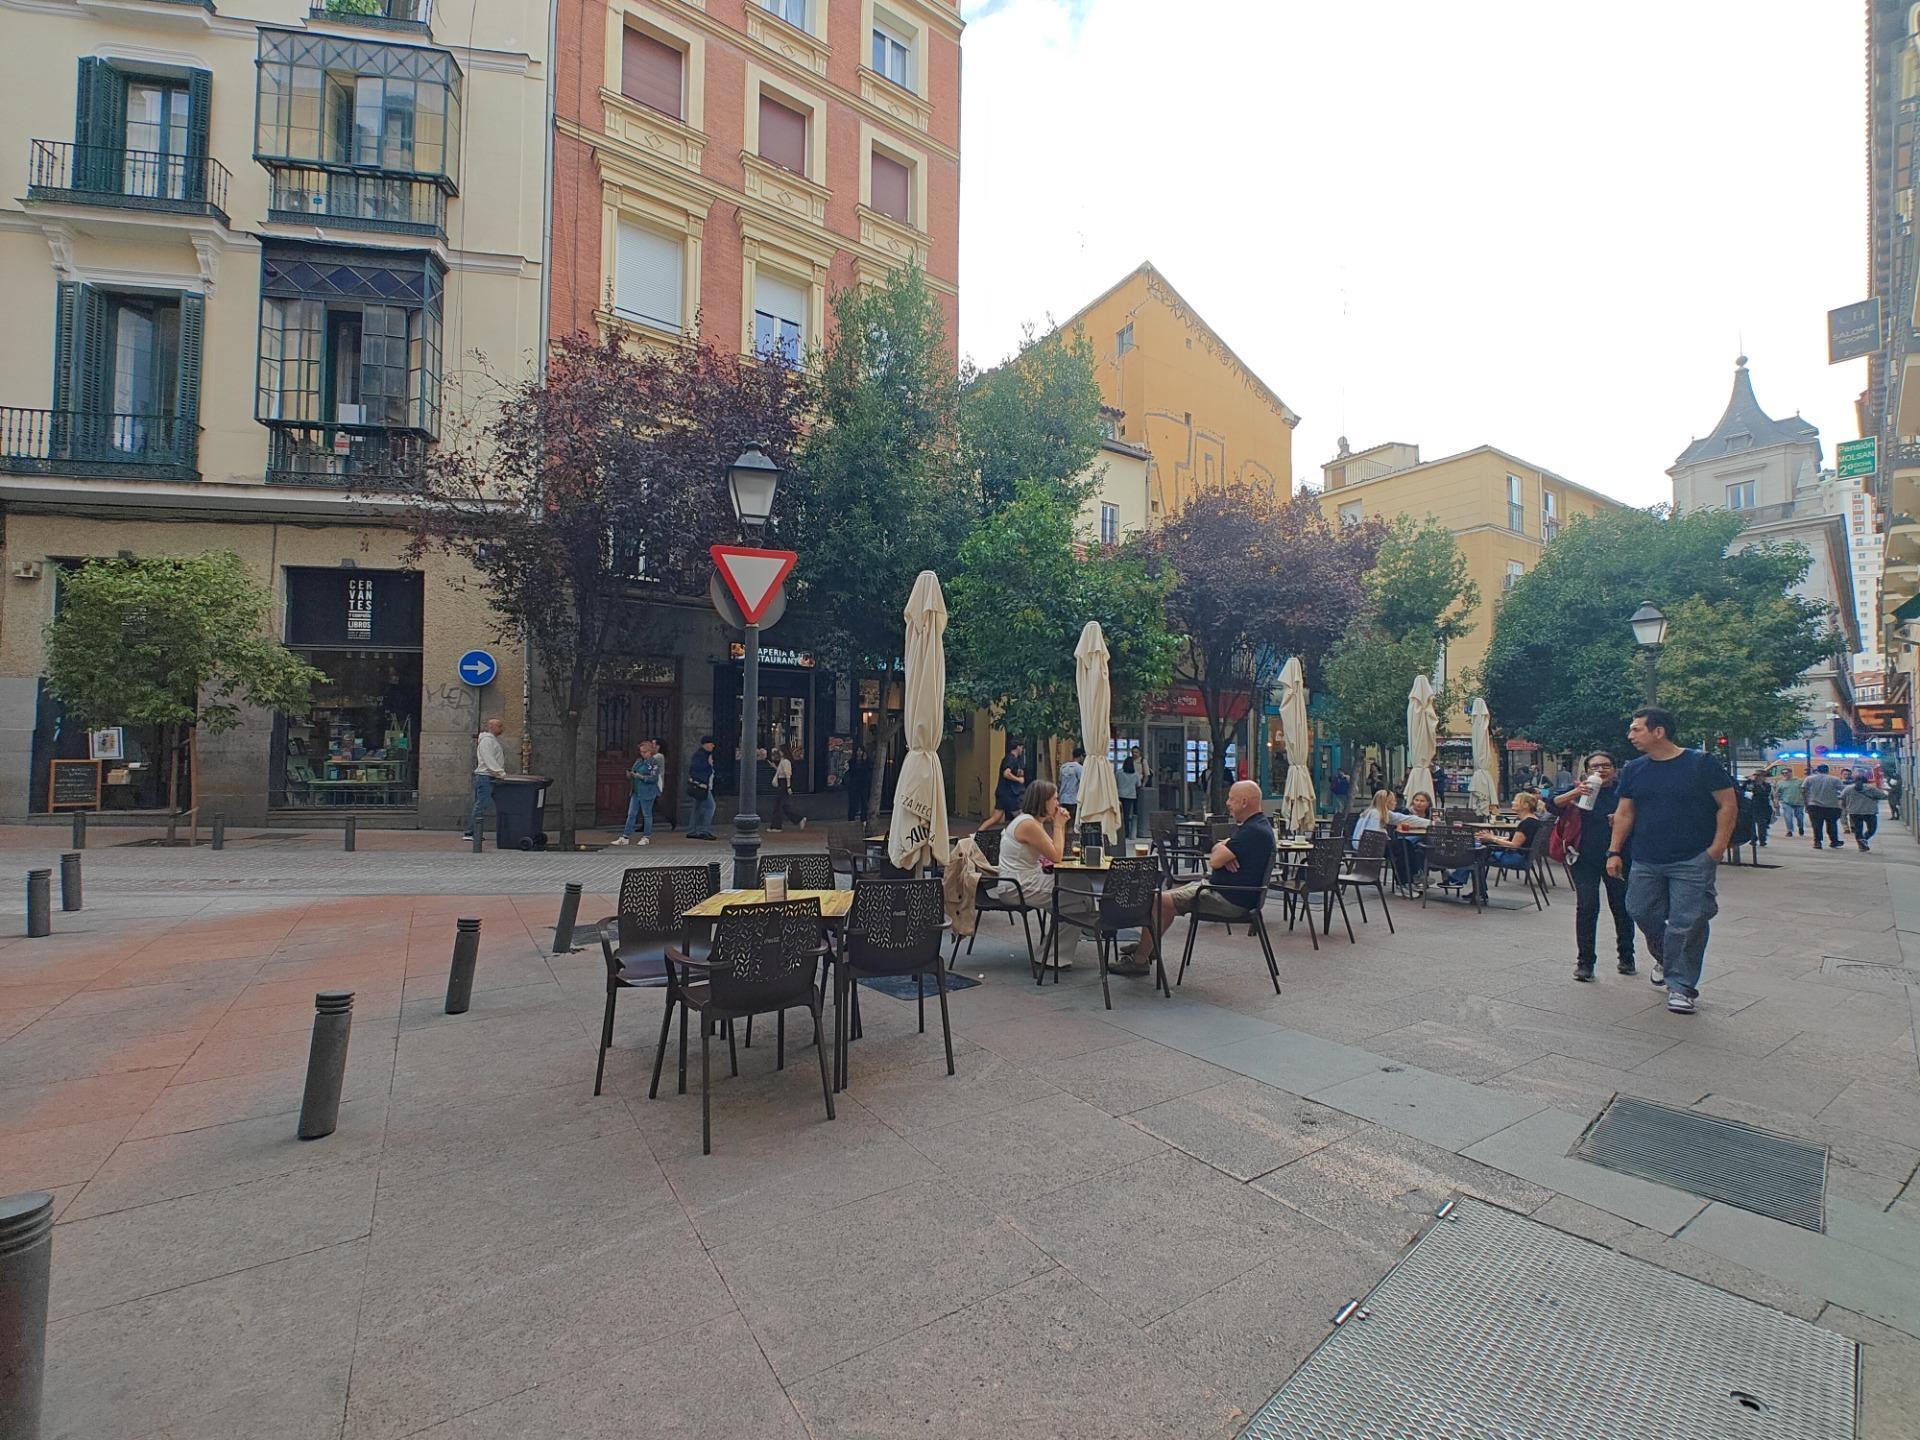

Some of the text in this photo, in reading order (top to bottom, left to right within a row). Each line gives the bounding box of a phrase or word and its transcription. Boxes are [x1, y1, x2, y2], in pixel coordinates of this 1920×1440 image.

[1839, 441, 1874, 453] Pensión
[349, 580, 373, 590] CER
[349, 590, 373, 600] VAN
[349, 600, 372, 610] TES
[757, 647, 788, 657] APERIA
[901, 795, 914, 809] ZA
